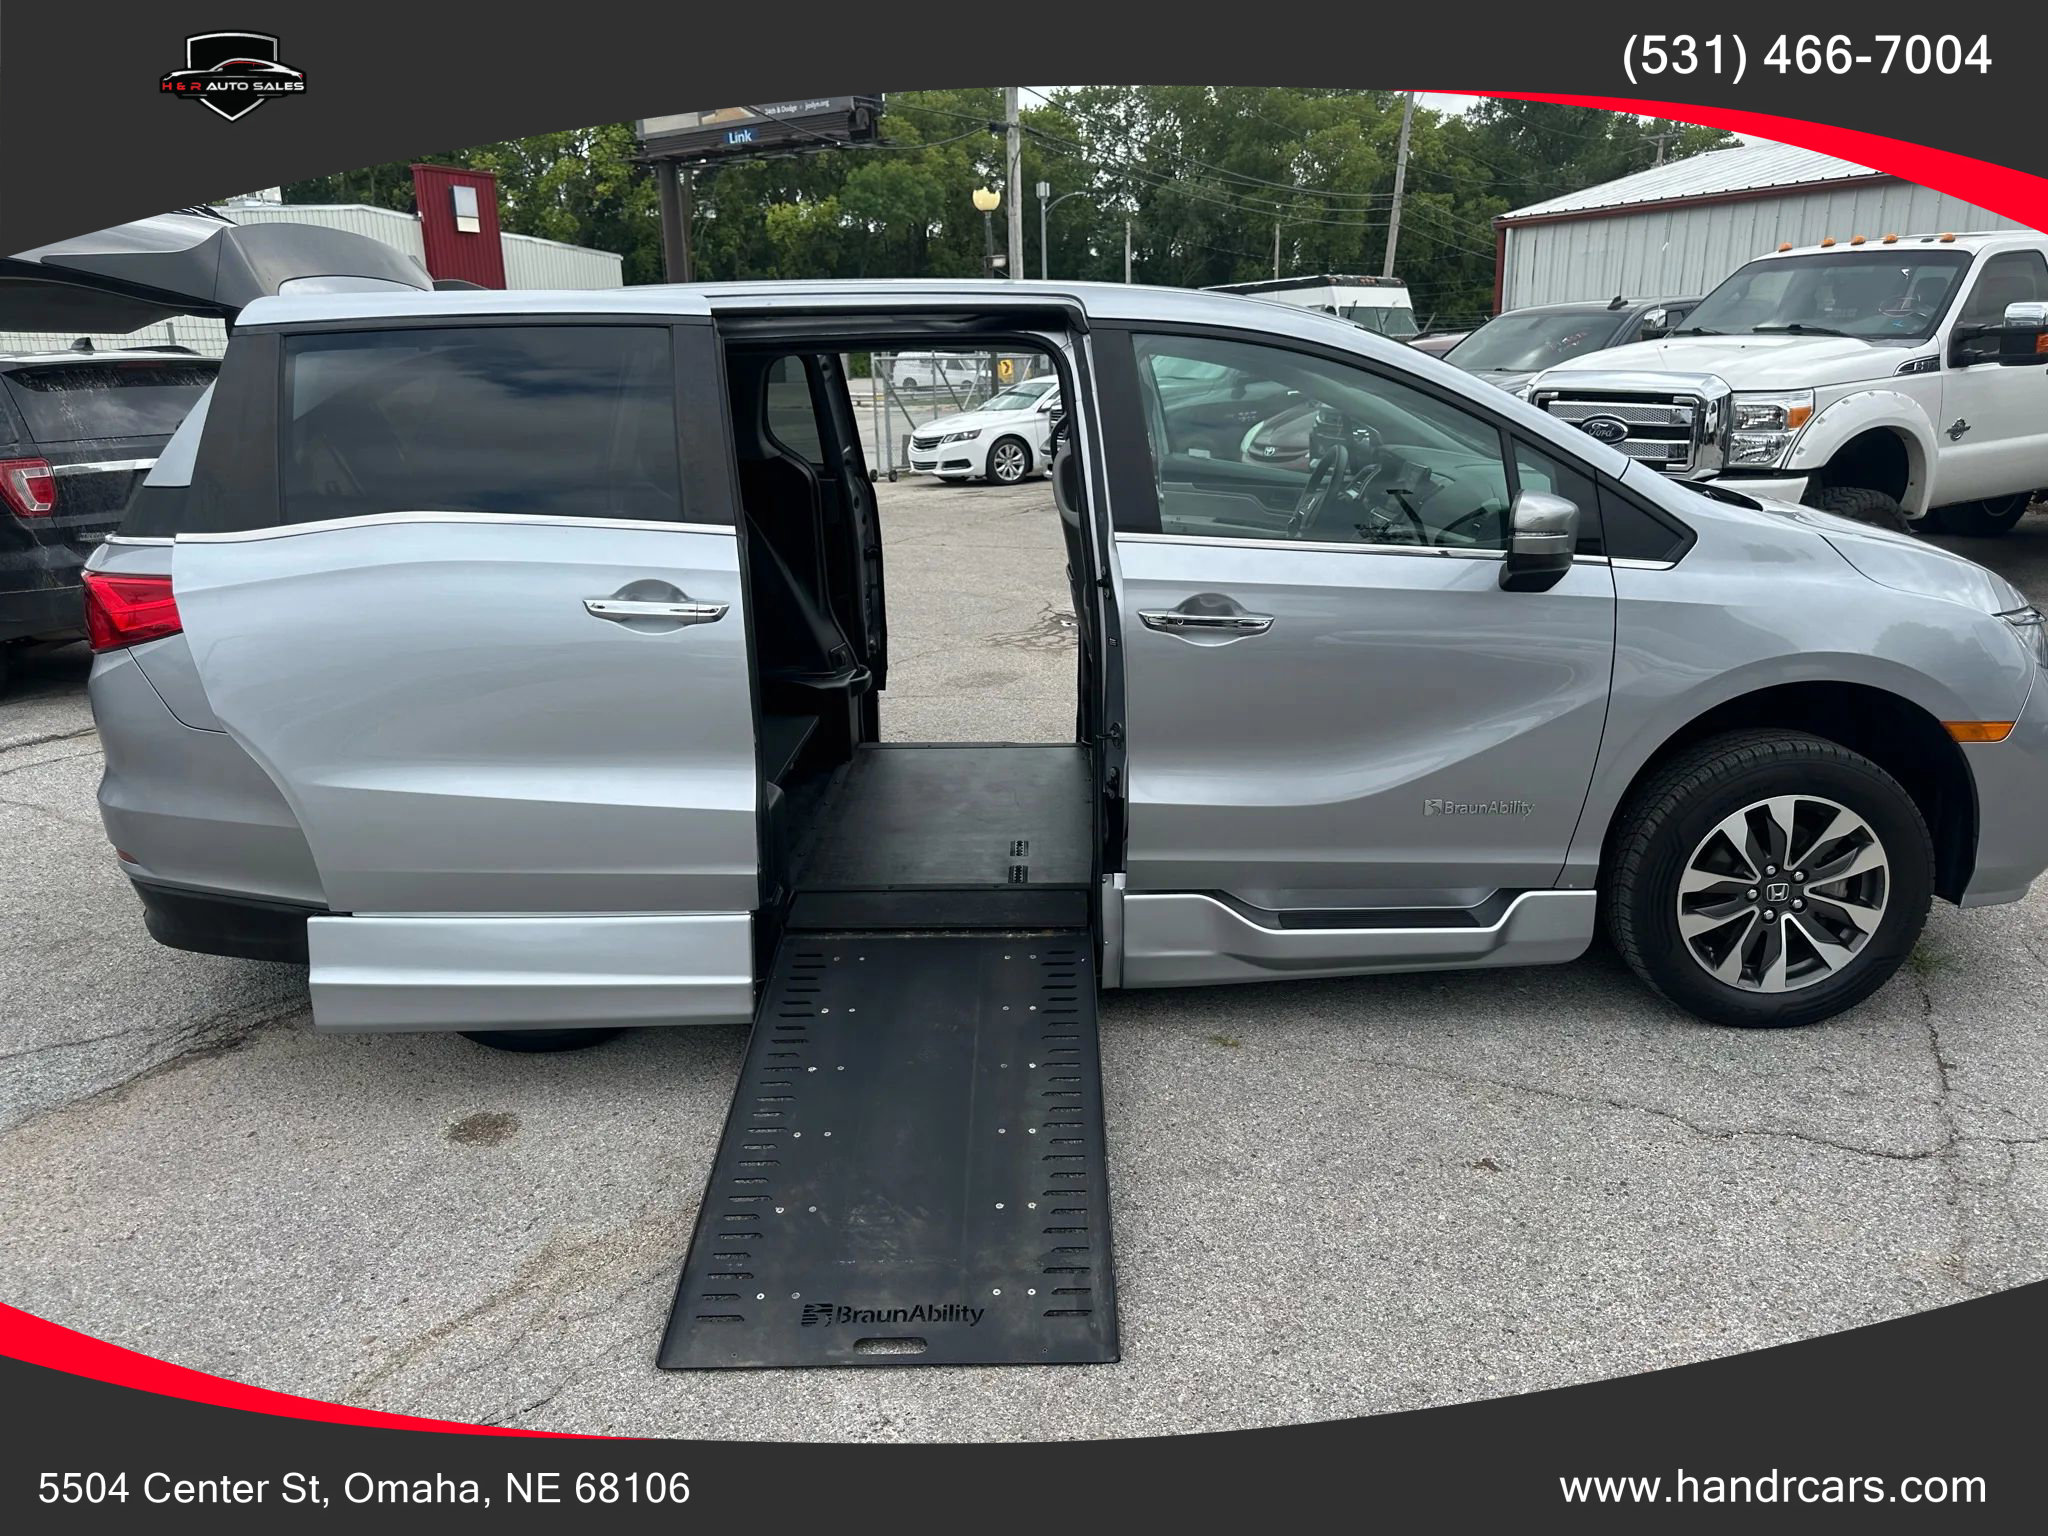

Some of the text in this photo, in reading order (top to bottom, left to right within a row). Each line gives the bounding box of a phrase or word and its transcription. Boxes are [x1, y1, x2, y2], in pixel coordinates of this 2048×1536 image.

[728, 129, 753, 144] Link
[1589, 422, 1615, 437] Ford
[1444, 800, 1535, 817] BraunAbility
[835, 1303, 985, 1327] BraunAbility
